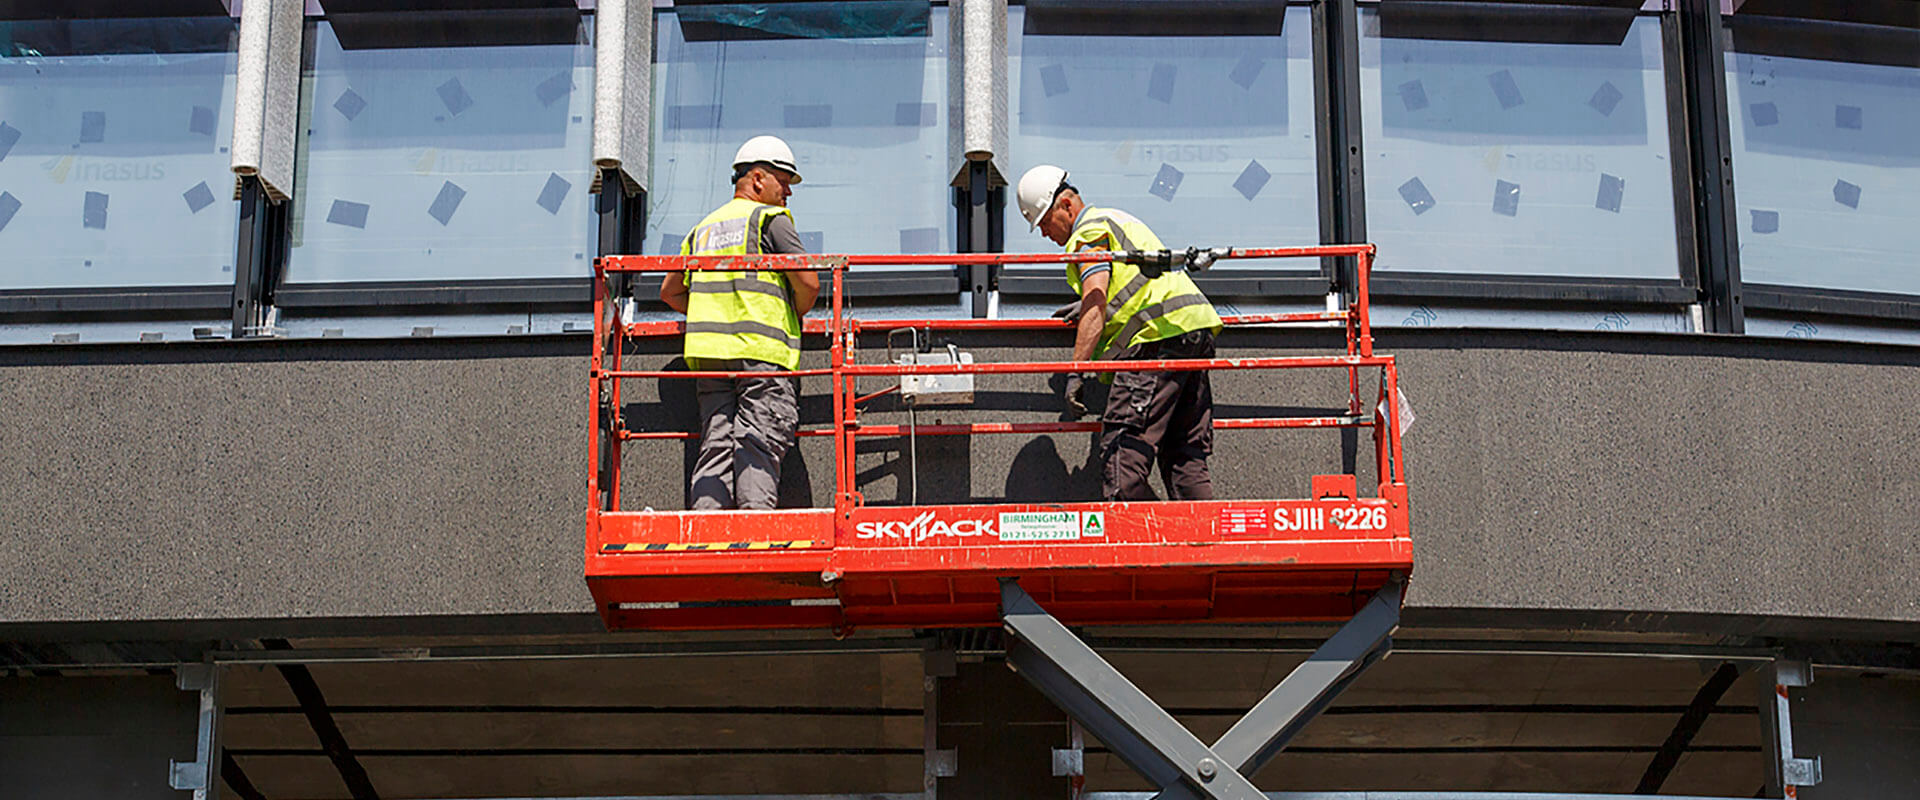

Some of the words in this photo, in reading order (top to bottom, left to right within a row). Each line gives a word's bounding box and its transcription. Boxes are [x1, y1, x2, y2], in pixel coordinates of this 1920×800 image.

[75, 157, 166, 181] inasus
[856, 511, 999, 542] SKYJACK
[1003, 514, 1075, 523] BIRMINGHAM
[1085, 514, 1101, 528] A
